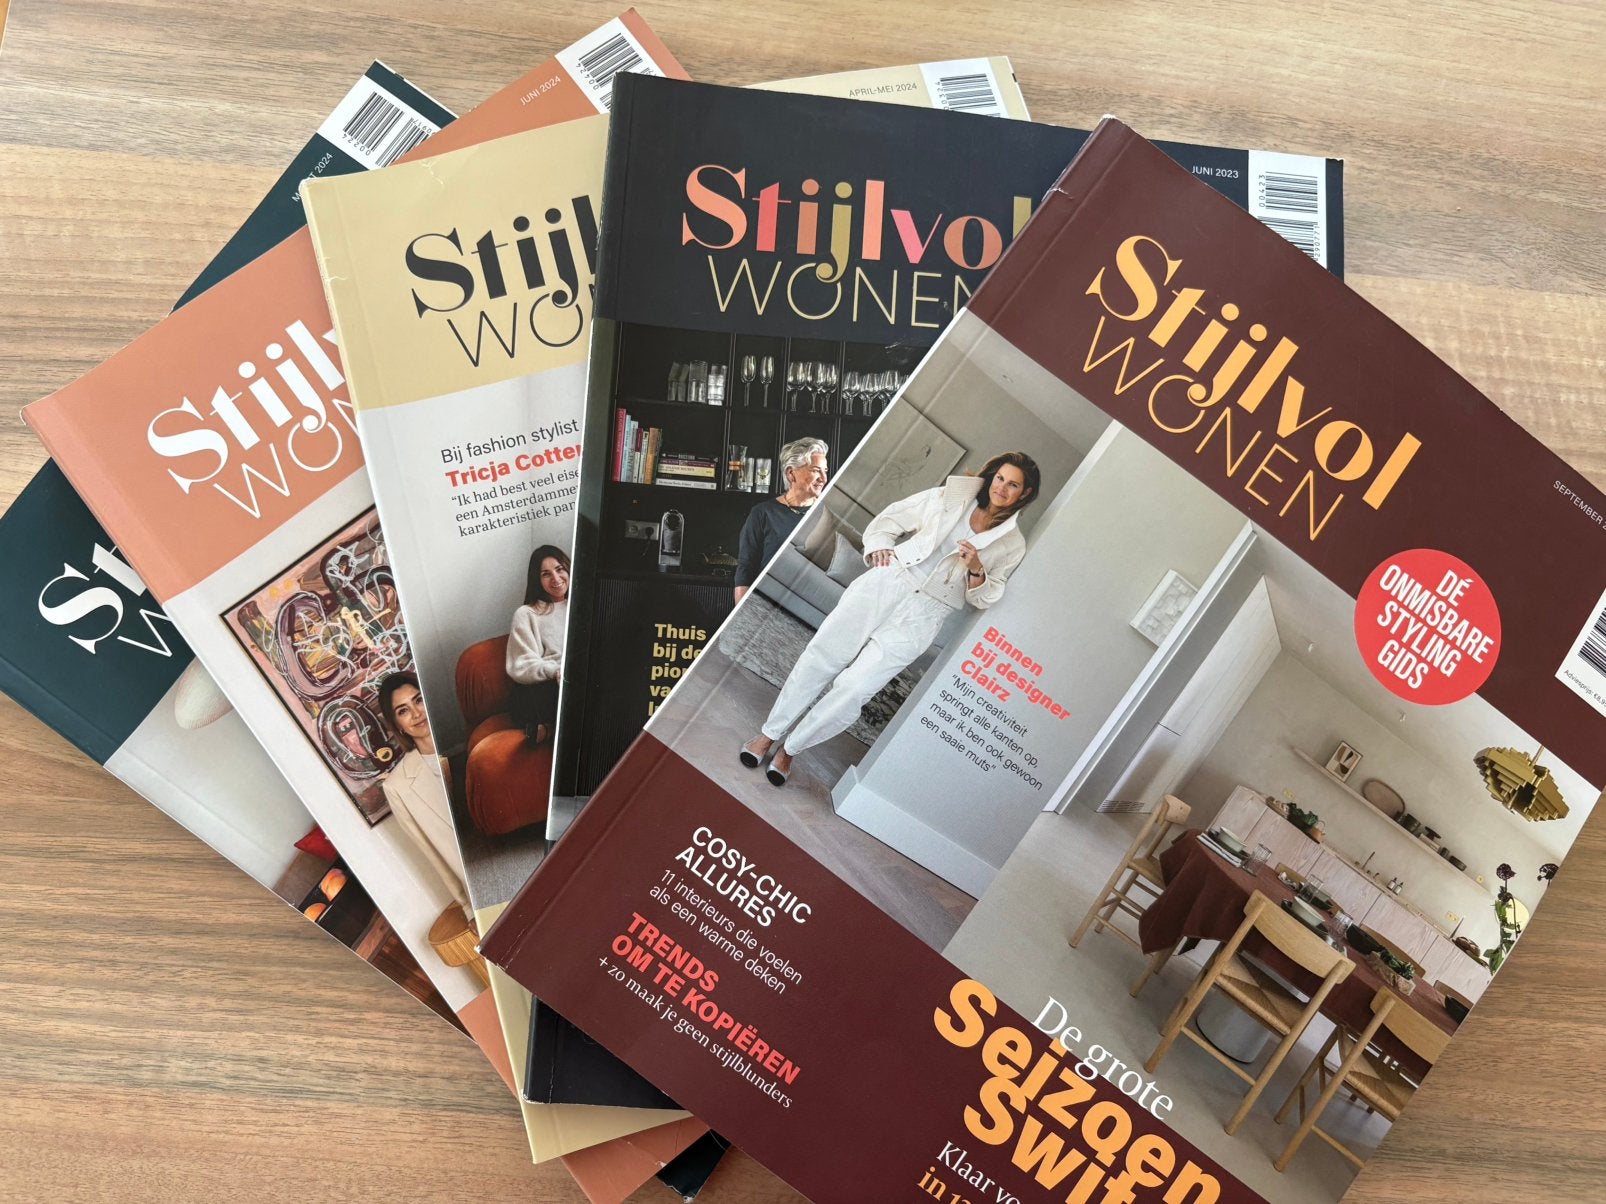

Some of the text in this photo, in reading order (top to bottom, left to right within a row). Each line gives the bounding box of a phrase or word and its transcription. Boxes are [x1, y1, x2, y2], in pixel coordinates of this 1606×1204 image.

[520, 75, 561, 105] JUNI 2024
[849, 82, 917, 97] APRIL-MEI 2024
[315, 152, 333, 173] 2024
[1192, 166, 1239, 178] JUNI 2023
[446, 284, 594, 367] WO
[1085, 235, 1422, 511] Stijlvol
[441, 419, 579, 464] Bij fashion stylist
[1083, 316, 1345, 541] WONEN
[445, 461, 511, 488] Tricja
[473, 487, 498, 503] had
[500, 481, 527, 497] best
[529, 473, 555, 489] veel
[455, 485, 578, 522] een Amsterdamme
[458, 505, 551, 537] karakteristiek
[1553, 480, 1603, 524] SEPTEMBER
[1436, 569, 1474, 607] DÉ
[654, 623, 707, 641] Thuis
[1377, 600, 1462, 677] STYLING
[1379, 564, 1495, 664] ONMISBARE
[652, 642, 677, 662] bij
[983, 626, 1044, 677] Binnen
[1377, 639, 1429, 689] GIDS
[960, 659, 1012, 702] Clairz
[971, 641, 1072, 721] bij designer
[920, 715, 939, 734] een
[939, 731, 965, 753] saaie
[939, 689, 1039, 769] springt alle kanten op,
[976, 696, 1029, 738] creativiteit
[930, 703, 1043, 791] maar ik ben ook gewoon
[675, 846, 776, 927] ALLURES
[692, 826, 812, 924] COSY-CHIC
[626, 911, 720, 993] TRENDS
[649, 885, 786, 995] als een warme deken
[661, 869, 802, 985] 11 interieurs die voelen
[611, 934, 801, 1085] OM TE KOPIËREN
[607, 964, 626, 982] zo
[625, 978, 666, 1012] maak
[660, 1005, 678, 1022] je
[673, 1017, 710, 1048] geen
[709, 1043, 793, 1109] stijlblunders
[1030, 995, 1174, 1121] De grote
[933, 978, 1221, 1204] Seizoen
[917, 1166, 947, 1201] in
[936, 1140, 996, 1194] Klaar
